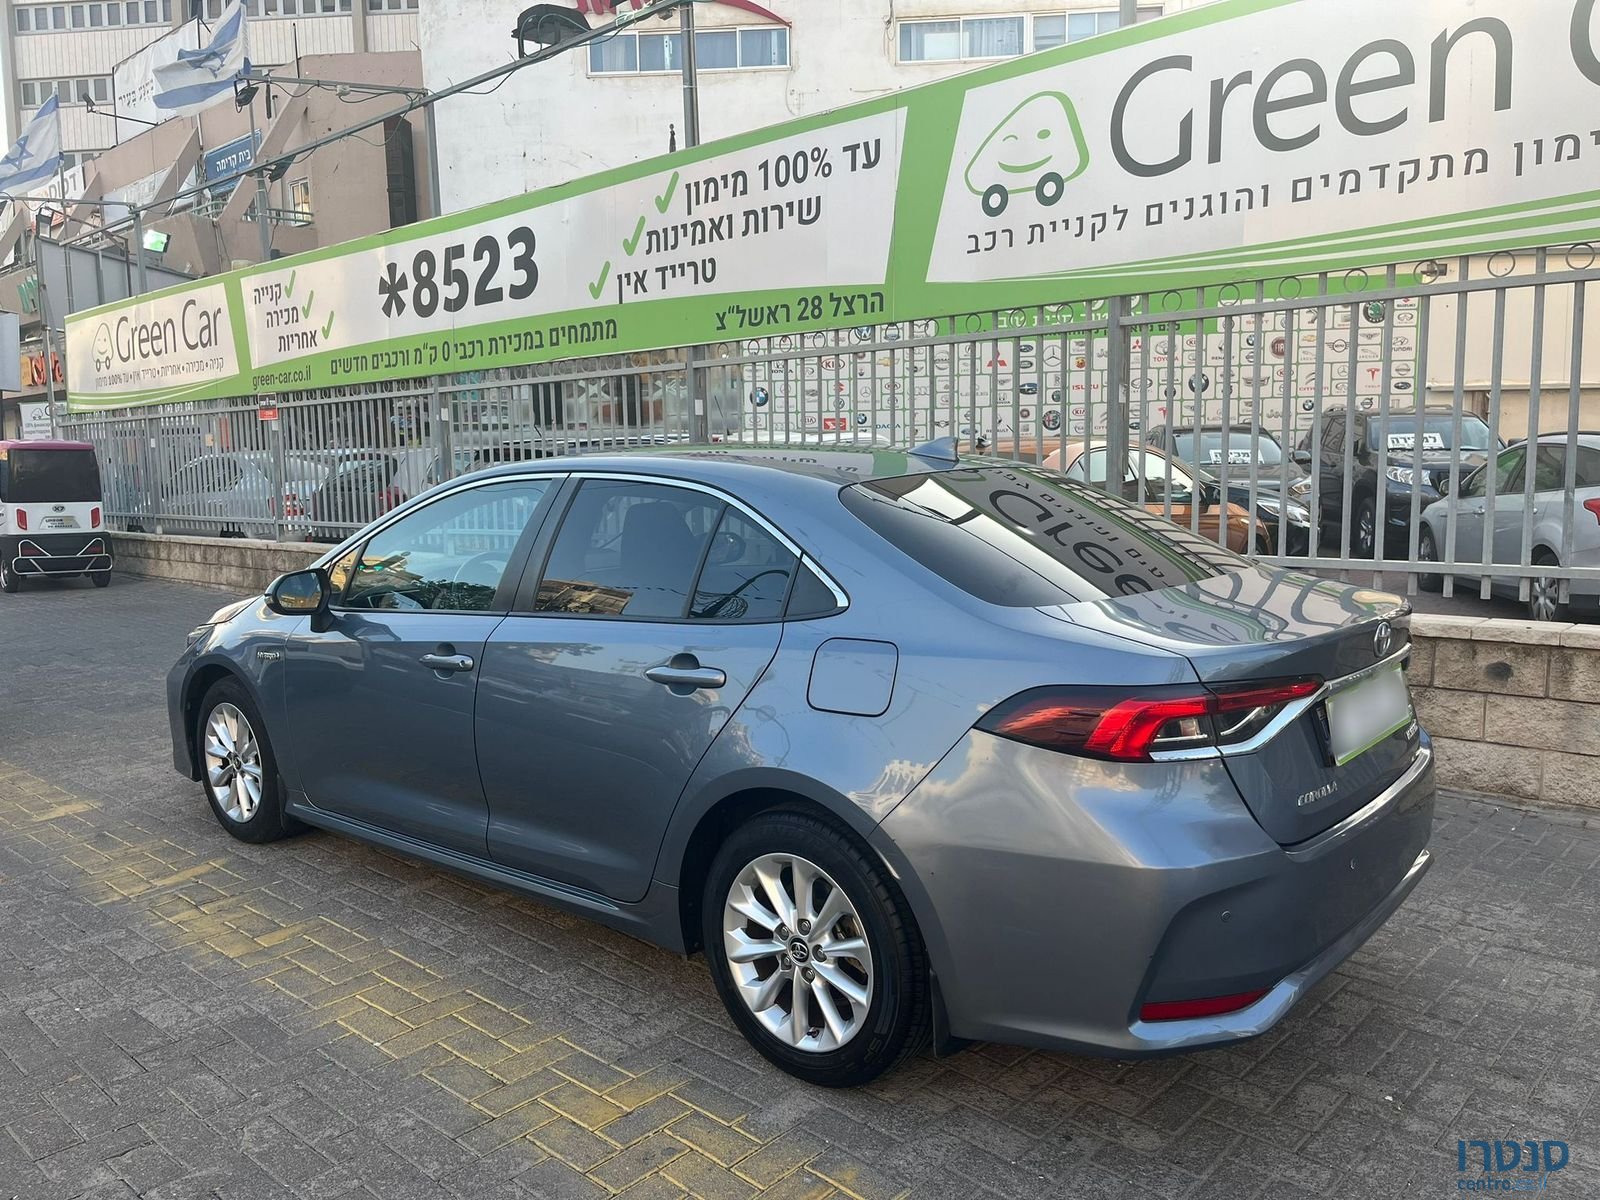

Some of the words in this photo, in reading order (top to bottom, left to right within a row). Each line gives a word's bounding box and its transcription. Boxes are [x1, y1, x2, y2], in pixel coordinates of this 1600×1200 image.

[1109, 15, 1514, 178] Green
[757, 146, 833, 191] 100%
[842, 137, 882, 173] עד
[1513, 128, 1600, 177] ימון
[684, 169, 749, 216] מימון
[1291, 147, 1490, 203] מתקדמים
[741, 195, 822, 238] שירות
[1145, 183, 1270, 227] והוגנים
[645, 213, 734, 256] ואמינות
[966, 228, 1015, 255] רכב
[1026, 204, 1129, 245] לקניית
[616, 269, 649, 305] אין
[655, 256, 718, 291] טרייד
[253, 280, 283, 306] קנייה
[797, 295, 823, 322] 28
[829, 291, 885, 317] הרצל
[116, 315, 177, 363] Green
[181, 298, 222, 351] Car
[265, 305, 300, 329] מכירה
[549, 318, 618, 347] מתמחים
[277, 327, 319, 353] אחריות
[454, 338, 485, 360] רכבי
[487, 329, 545, 356] במכירת
[330, 355, 368, 376] חדשים
[371, 349, 410, 370] ורכבים
[252, 365, 312, 391] green-car.co.il
